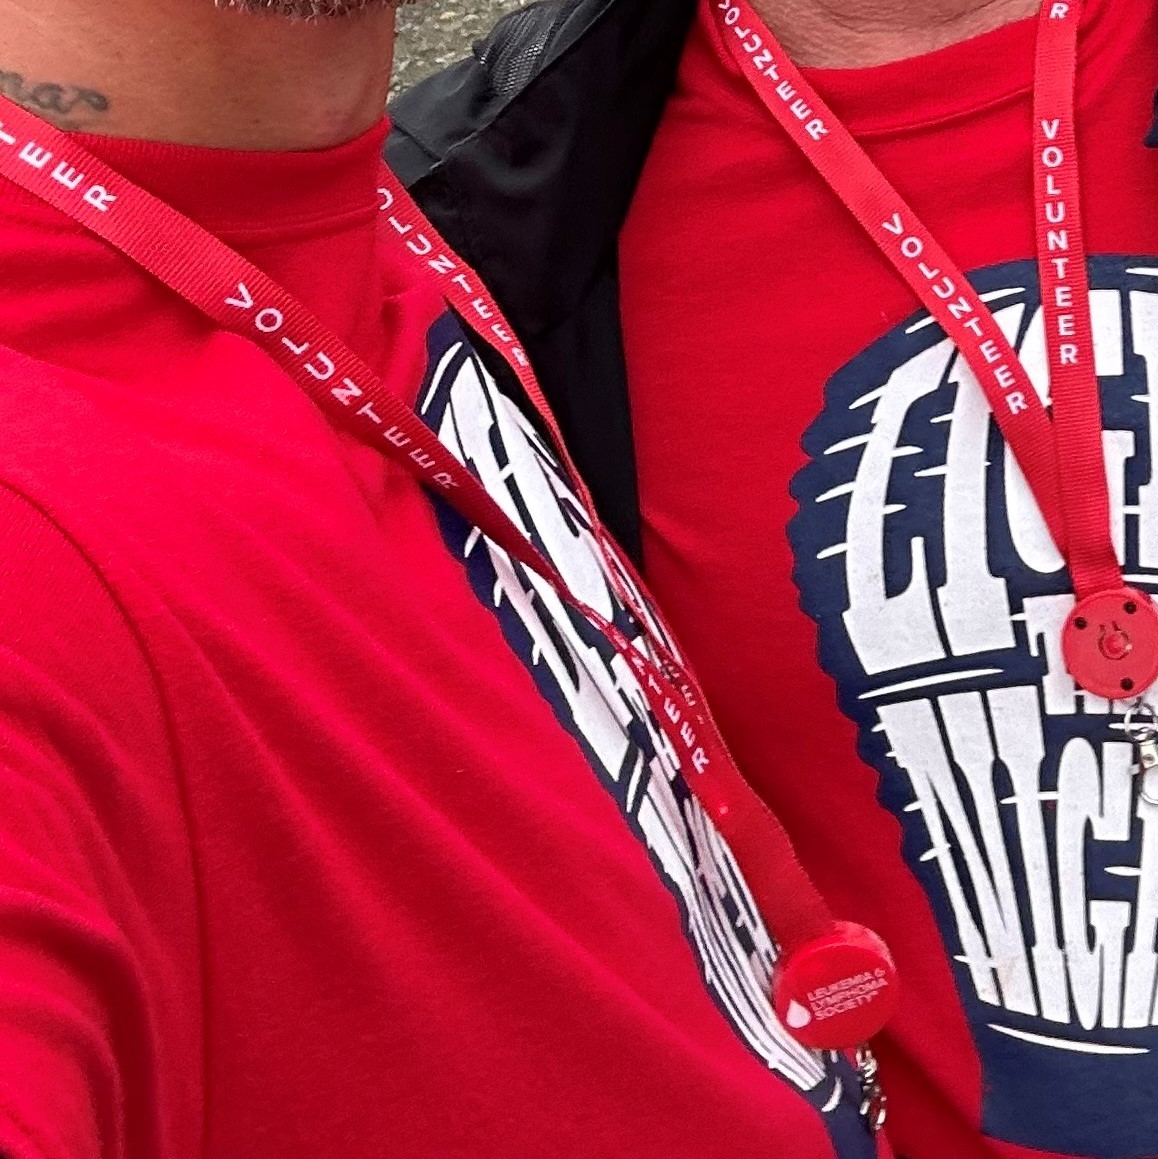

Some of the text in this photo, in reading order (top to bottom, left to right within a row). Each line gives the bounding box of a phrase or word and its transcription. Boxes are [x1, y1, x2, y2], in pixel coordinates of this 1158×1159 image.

[881, 213, 1028, 415] VOLUNTEER
[1040, 118, 1079, 366] VOLUNTEER
[224, 282, 460, 488] VOLUNTEER
